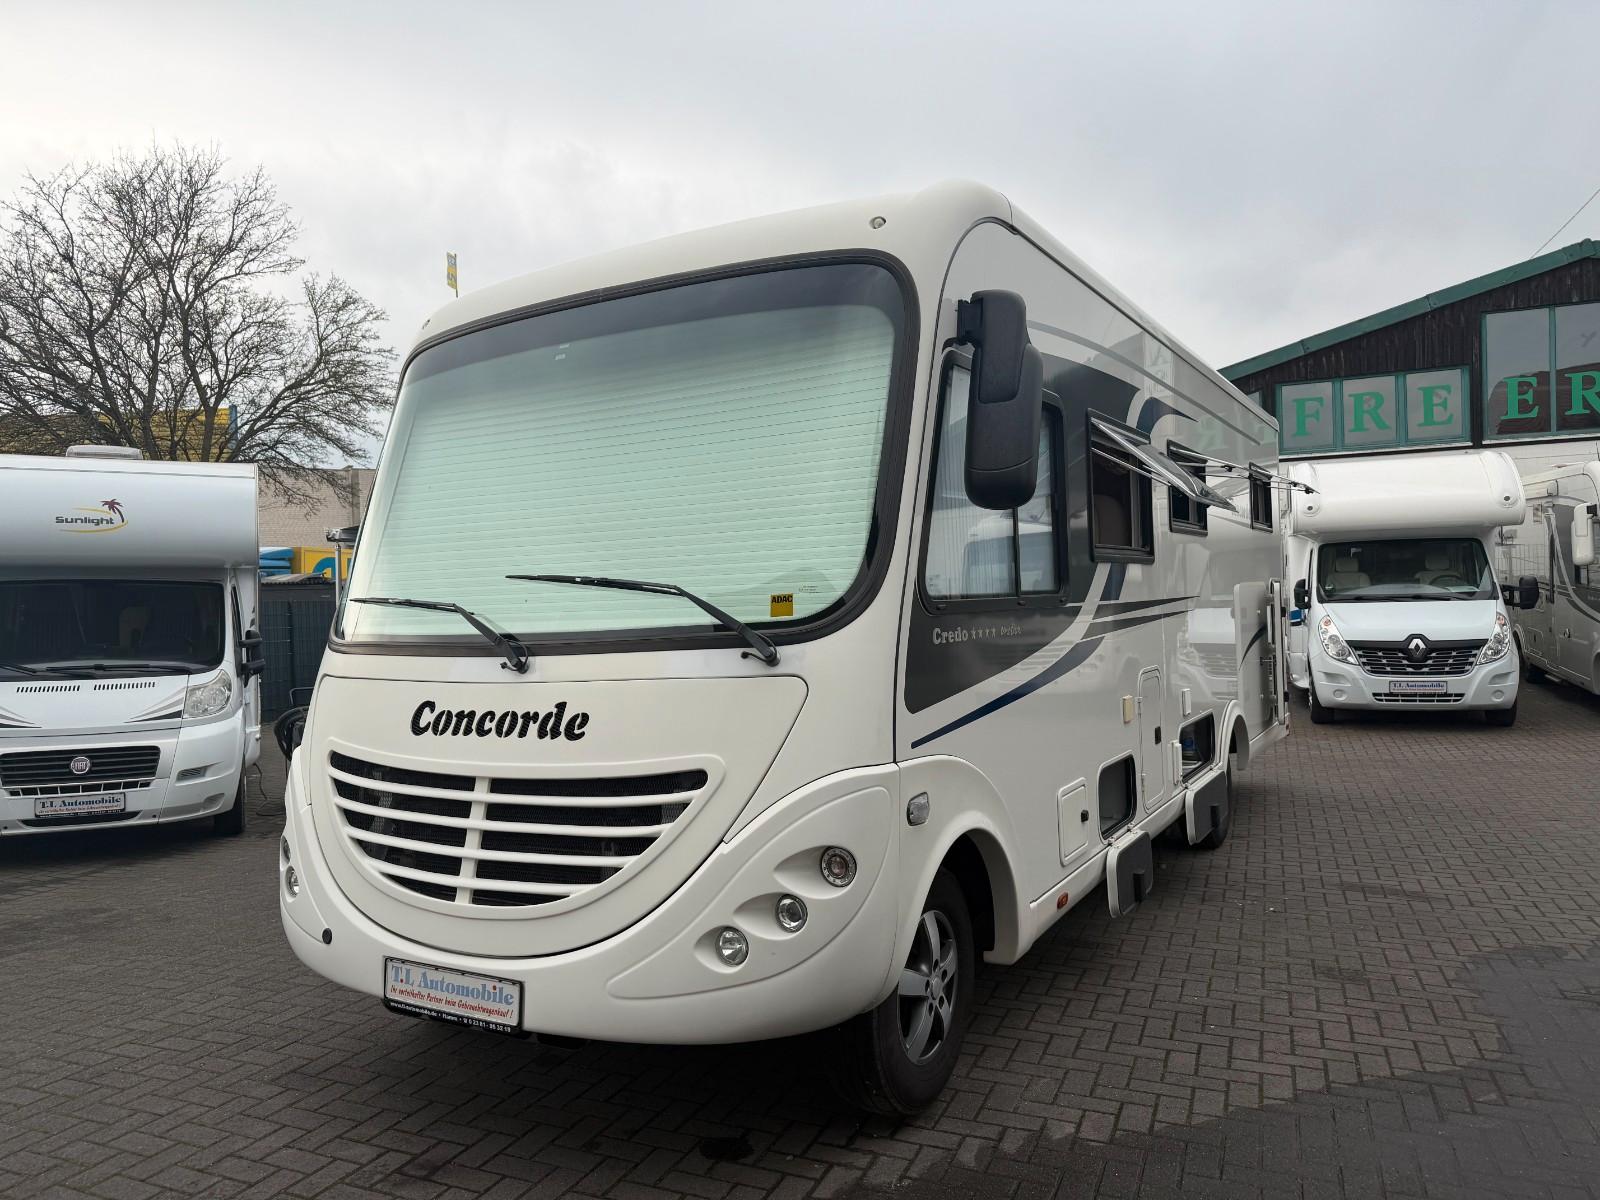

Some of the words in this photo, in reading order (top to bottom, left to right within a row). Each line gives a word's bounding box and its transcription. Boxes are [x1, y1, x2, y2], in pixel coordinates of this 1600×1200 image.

[55, 516, 115, 526] Sunlight
[771, 595, 793, 604] ADAC
[932, 627, 969, 645] Credo
[410, 700, 590, 742] Concorde
[60, 796, 121, 808] Automobile
[418, 971, 514, 1005] Automobile
[426, 993, 444, 1004] Partner
